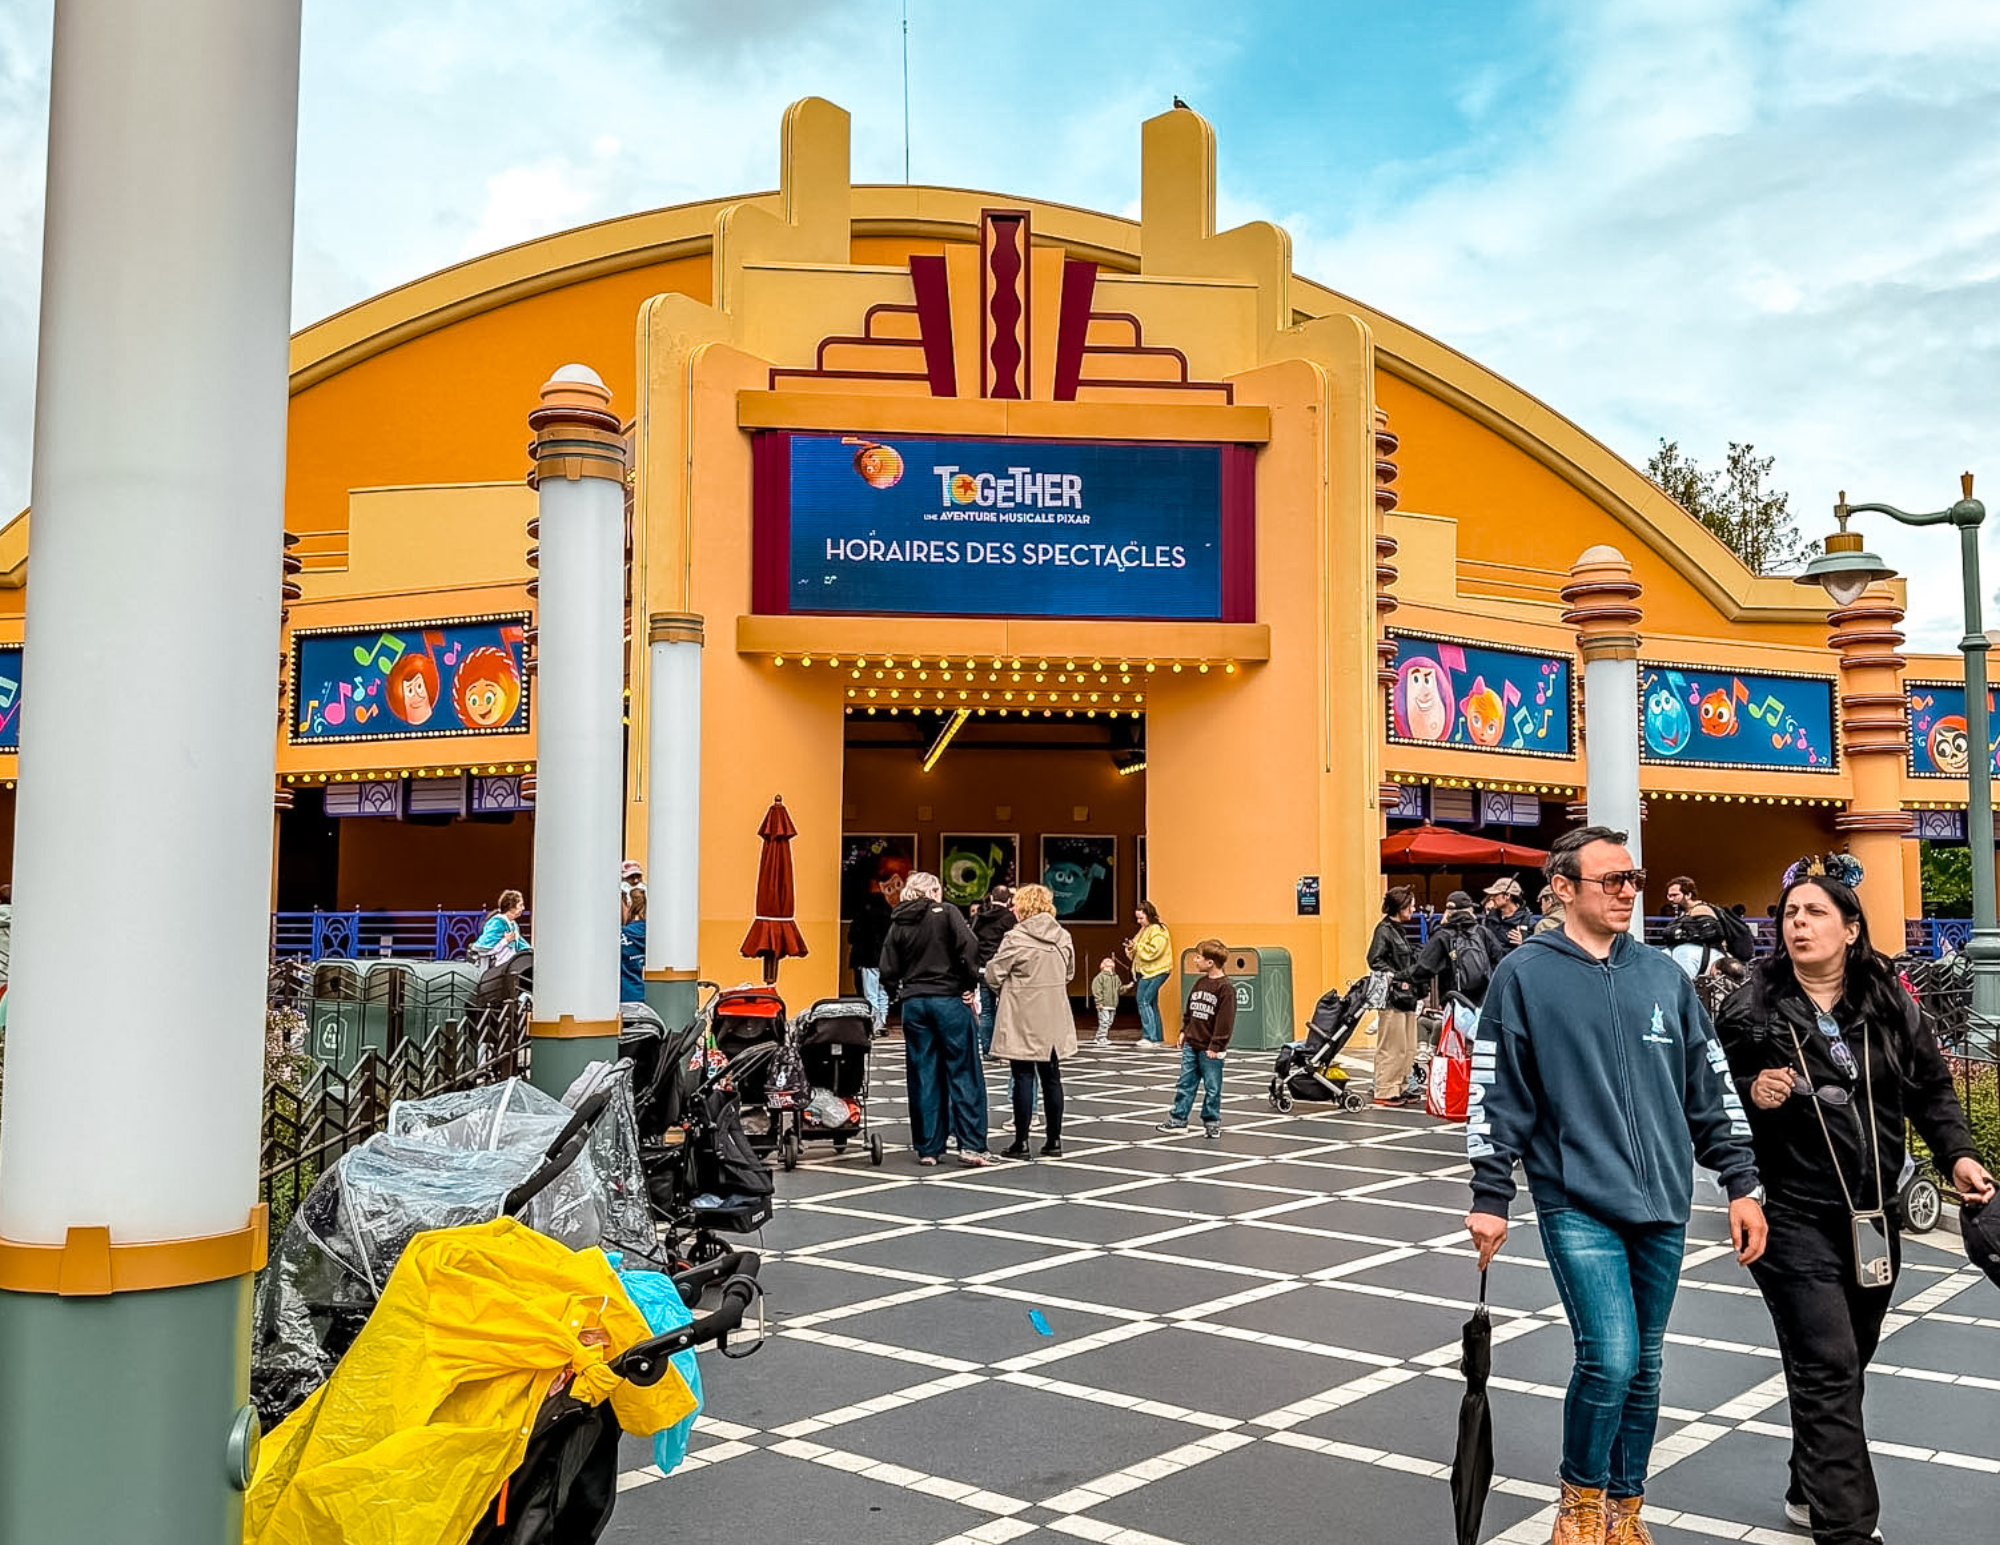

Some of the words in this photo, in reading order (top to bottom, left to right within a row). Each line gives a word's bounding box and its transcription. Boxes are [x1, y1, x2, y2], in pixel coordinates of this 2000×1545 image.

[933, 465, 1083, 509] TOGETHER
[939, 511, 997, 522] AVENTURE
[999, 513, 1055, 523] MUSICALE
[1057, 514, 1091, 525] PIXAR
[826, 538, 961, 564] HORAIRES
[966, 542, 1017, 565] DES
[1022, 543, 1187, 568] SPECTACLES
